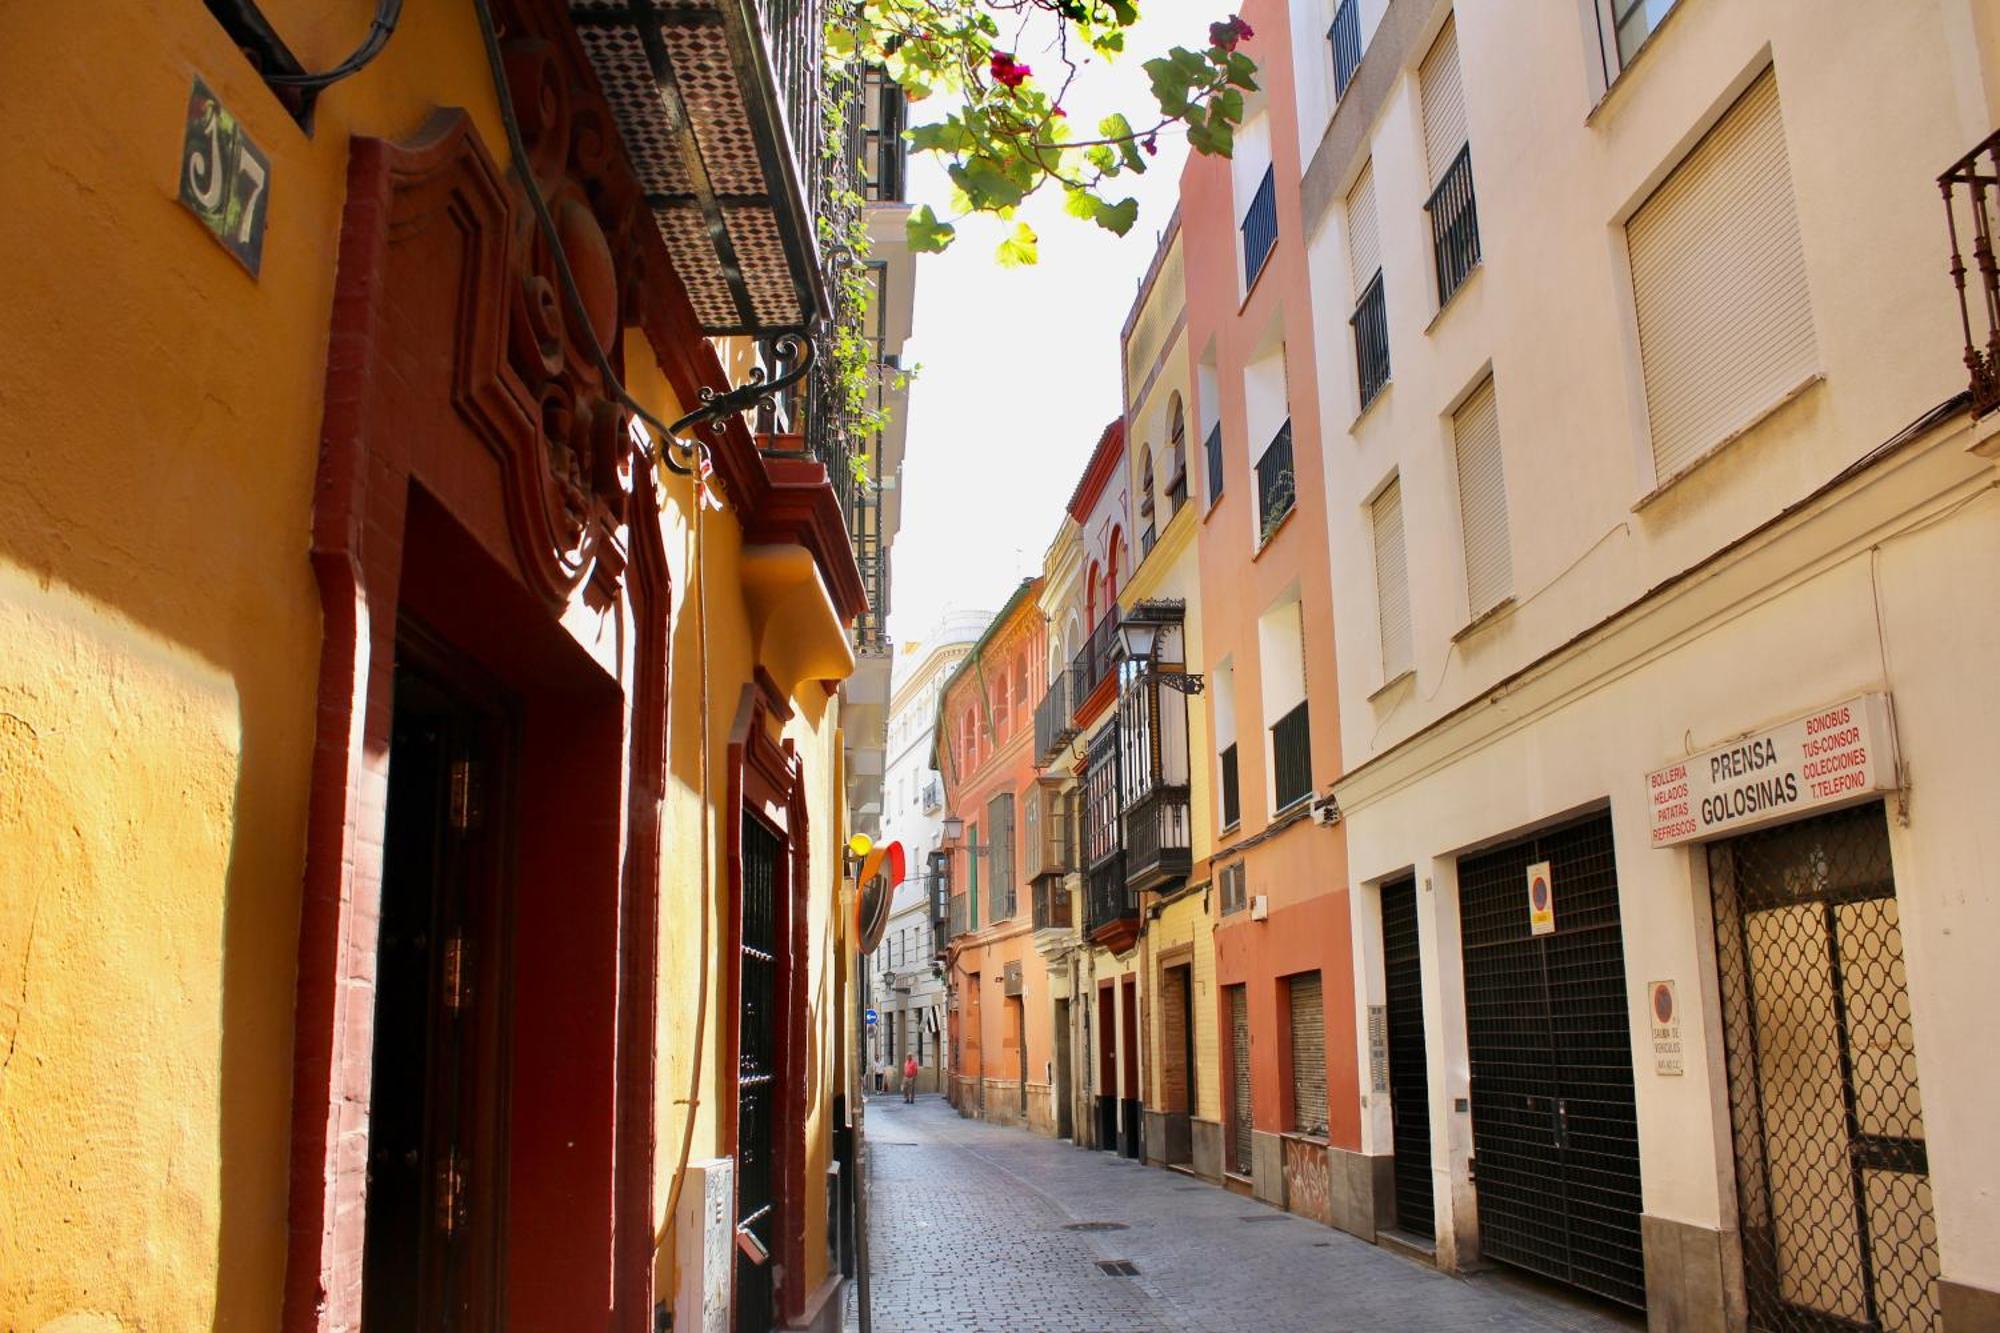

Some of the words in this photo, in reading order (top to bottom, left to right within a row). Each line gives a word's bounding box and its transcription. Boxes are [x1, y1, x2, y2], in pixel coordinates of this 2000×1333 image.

[1806, 707, 1850, 735] BONOBUS
[1802, 727, 1860, 759] TUS-CONSOR
[1711, 738, 1777, 783] PRENSA
[1803, 748, 1866, 780] COLECCIONES
[1651, 765, 1687, 788] BOLLERIA
[1811, 771, 1865, 799] T.TELEFONO
[1655, 783, 1689, 805] HELADOS
[1702, 773, 1798, 825] GOLOSINAS
[1658, 802, 1689, 822] PATATAS
[1653, 819, 1697, 841] REFRESCOS
